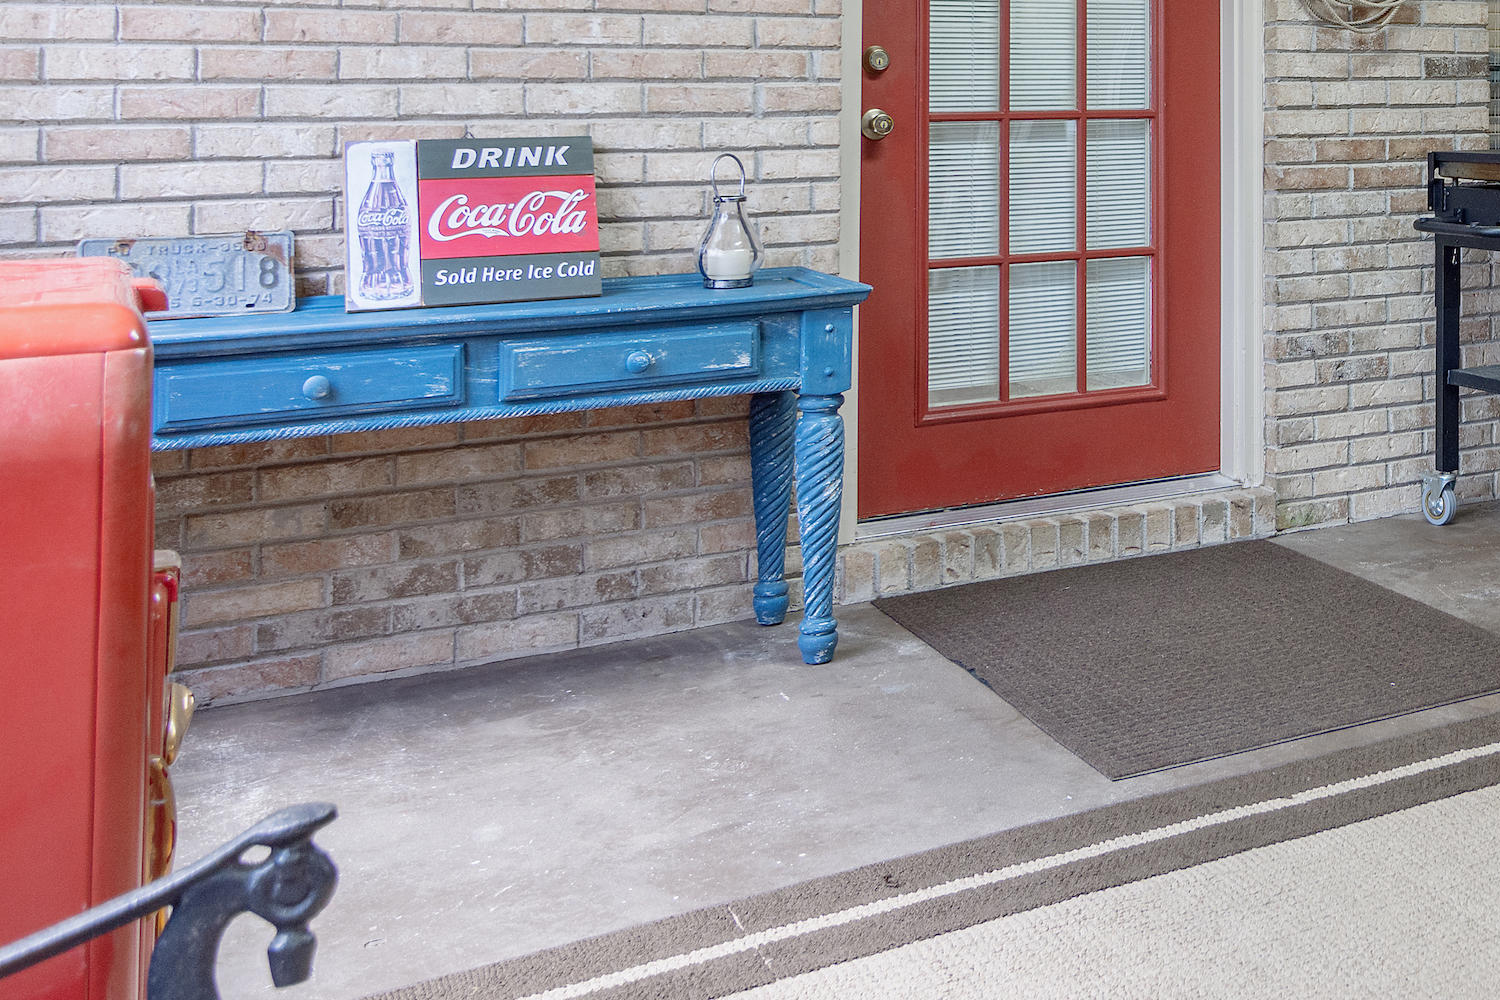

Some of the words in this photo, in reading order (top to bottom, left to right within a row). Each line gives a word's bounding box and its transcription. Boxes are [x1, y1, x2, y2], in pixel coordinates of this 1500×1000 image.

[451, 145, 571, 169] DRINK
[358, 208, 409, 227] Coca-Cola
[428, 188, 591, 242] Coca-Cola
[434, 267, 478, 287] Sold
[481, 265, 523, 283] Here
[528, 264, 553, 280] Ice
[557, 260, 595, 278] Cold
